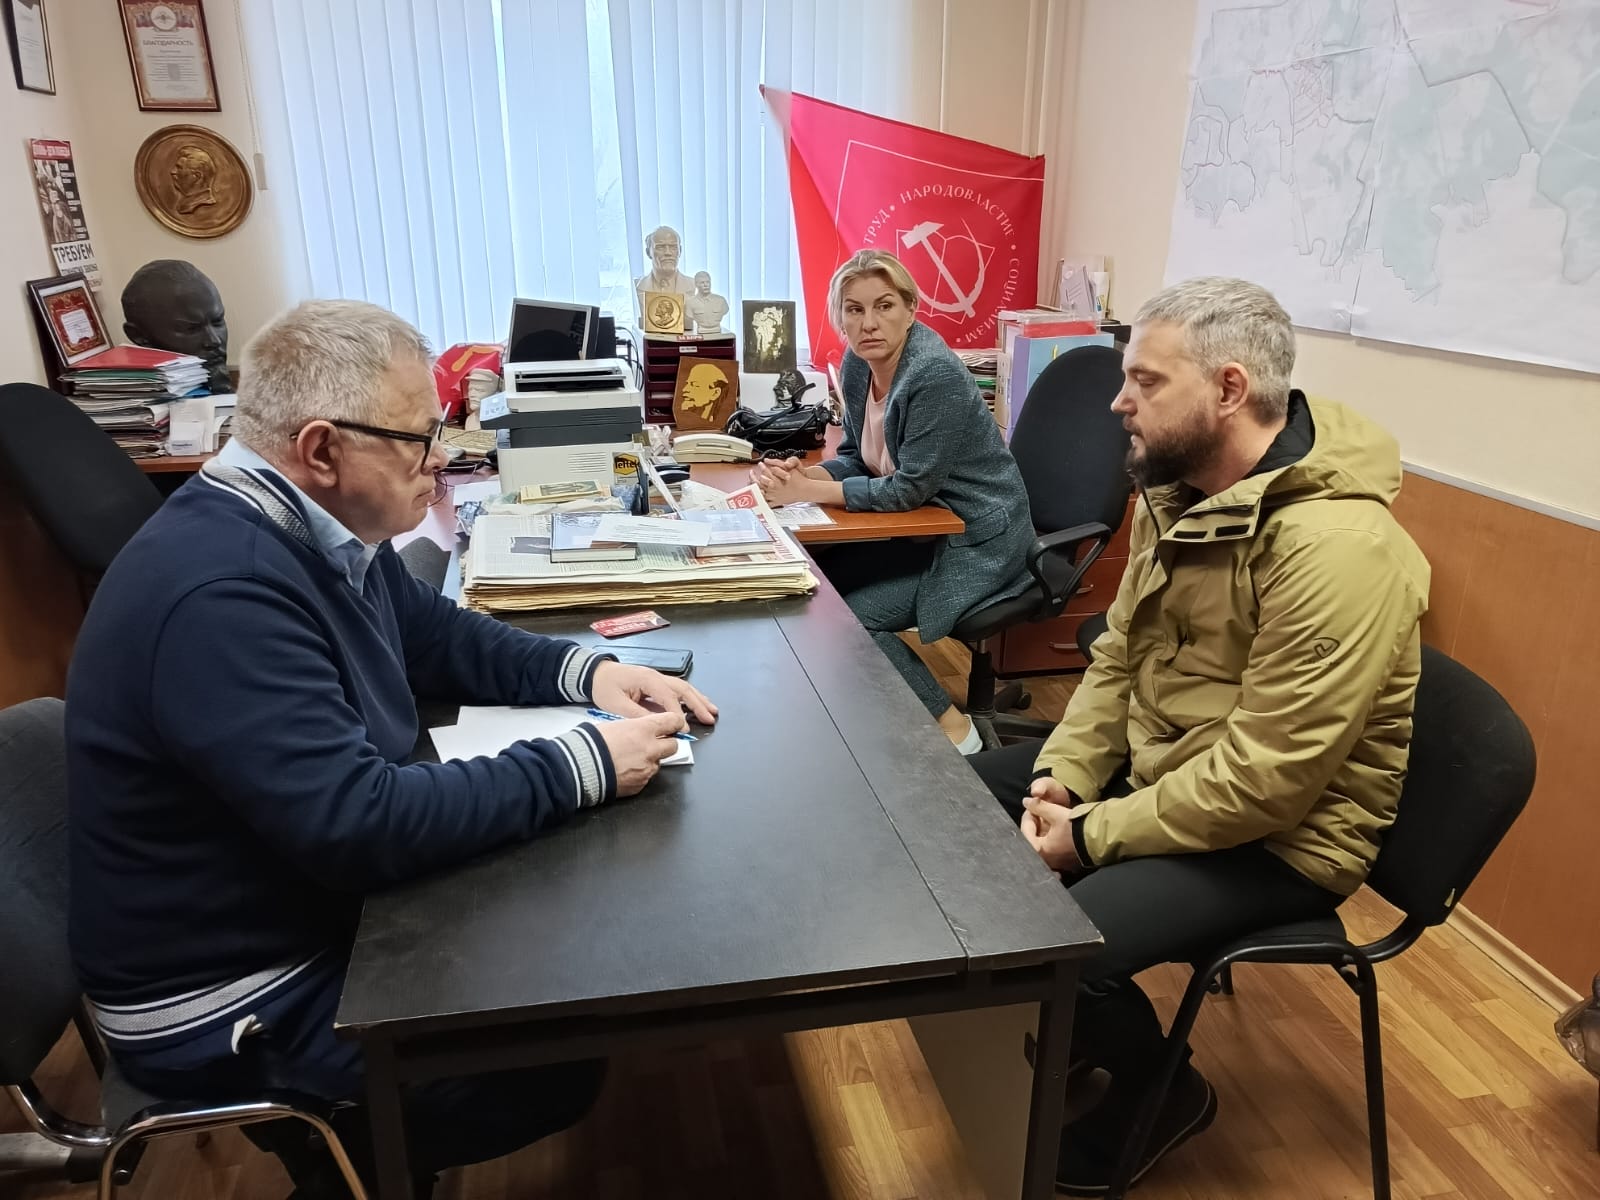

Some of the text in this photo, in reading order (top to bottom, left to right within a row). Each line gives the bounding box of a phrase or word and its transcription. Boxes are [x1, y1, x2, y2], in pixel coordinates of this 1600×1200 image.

[863, 208, 890, 245] ТРУД
[899, 184, 1015, 238] НАРОДОВЛАСТИЕ
[53, 243, 95, 263] ТРЕБУЕМ
